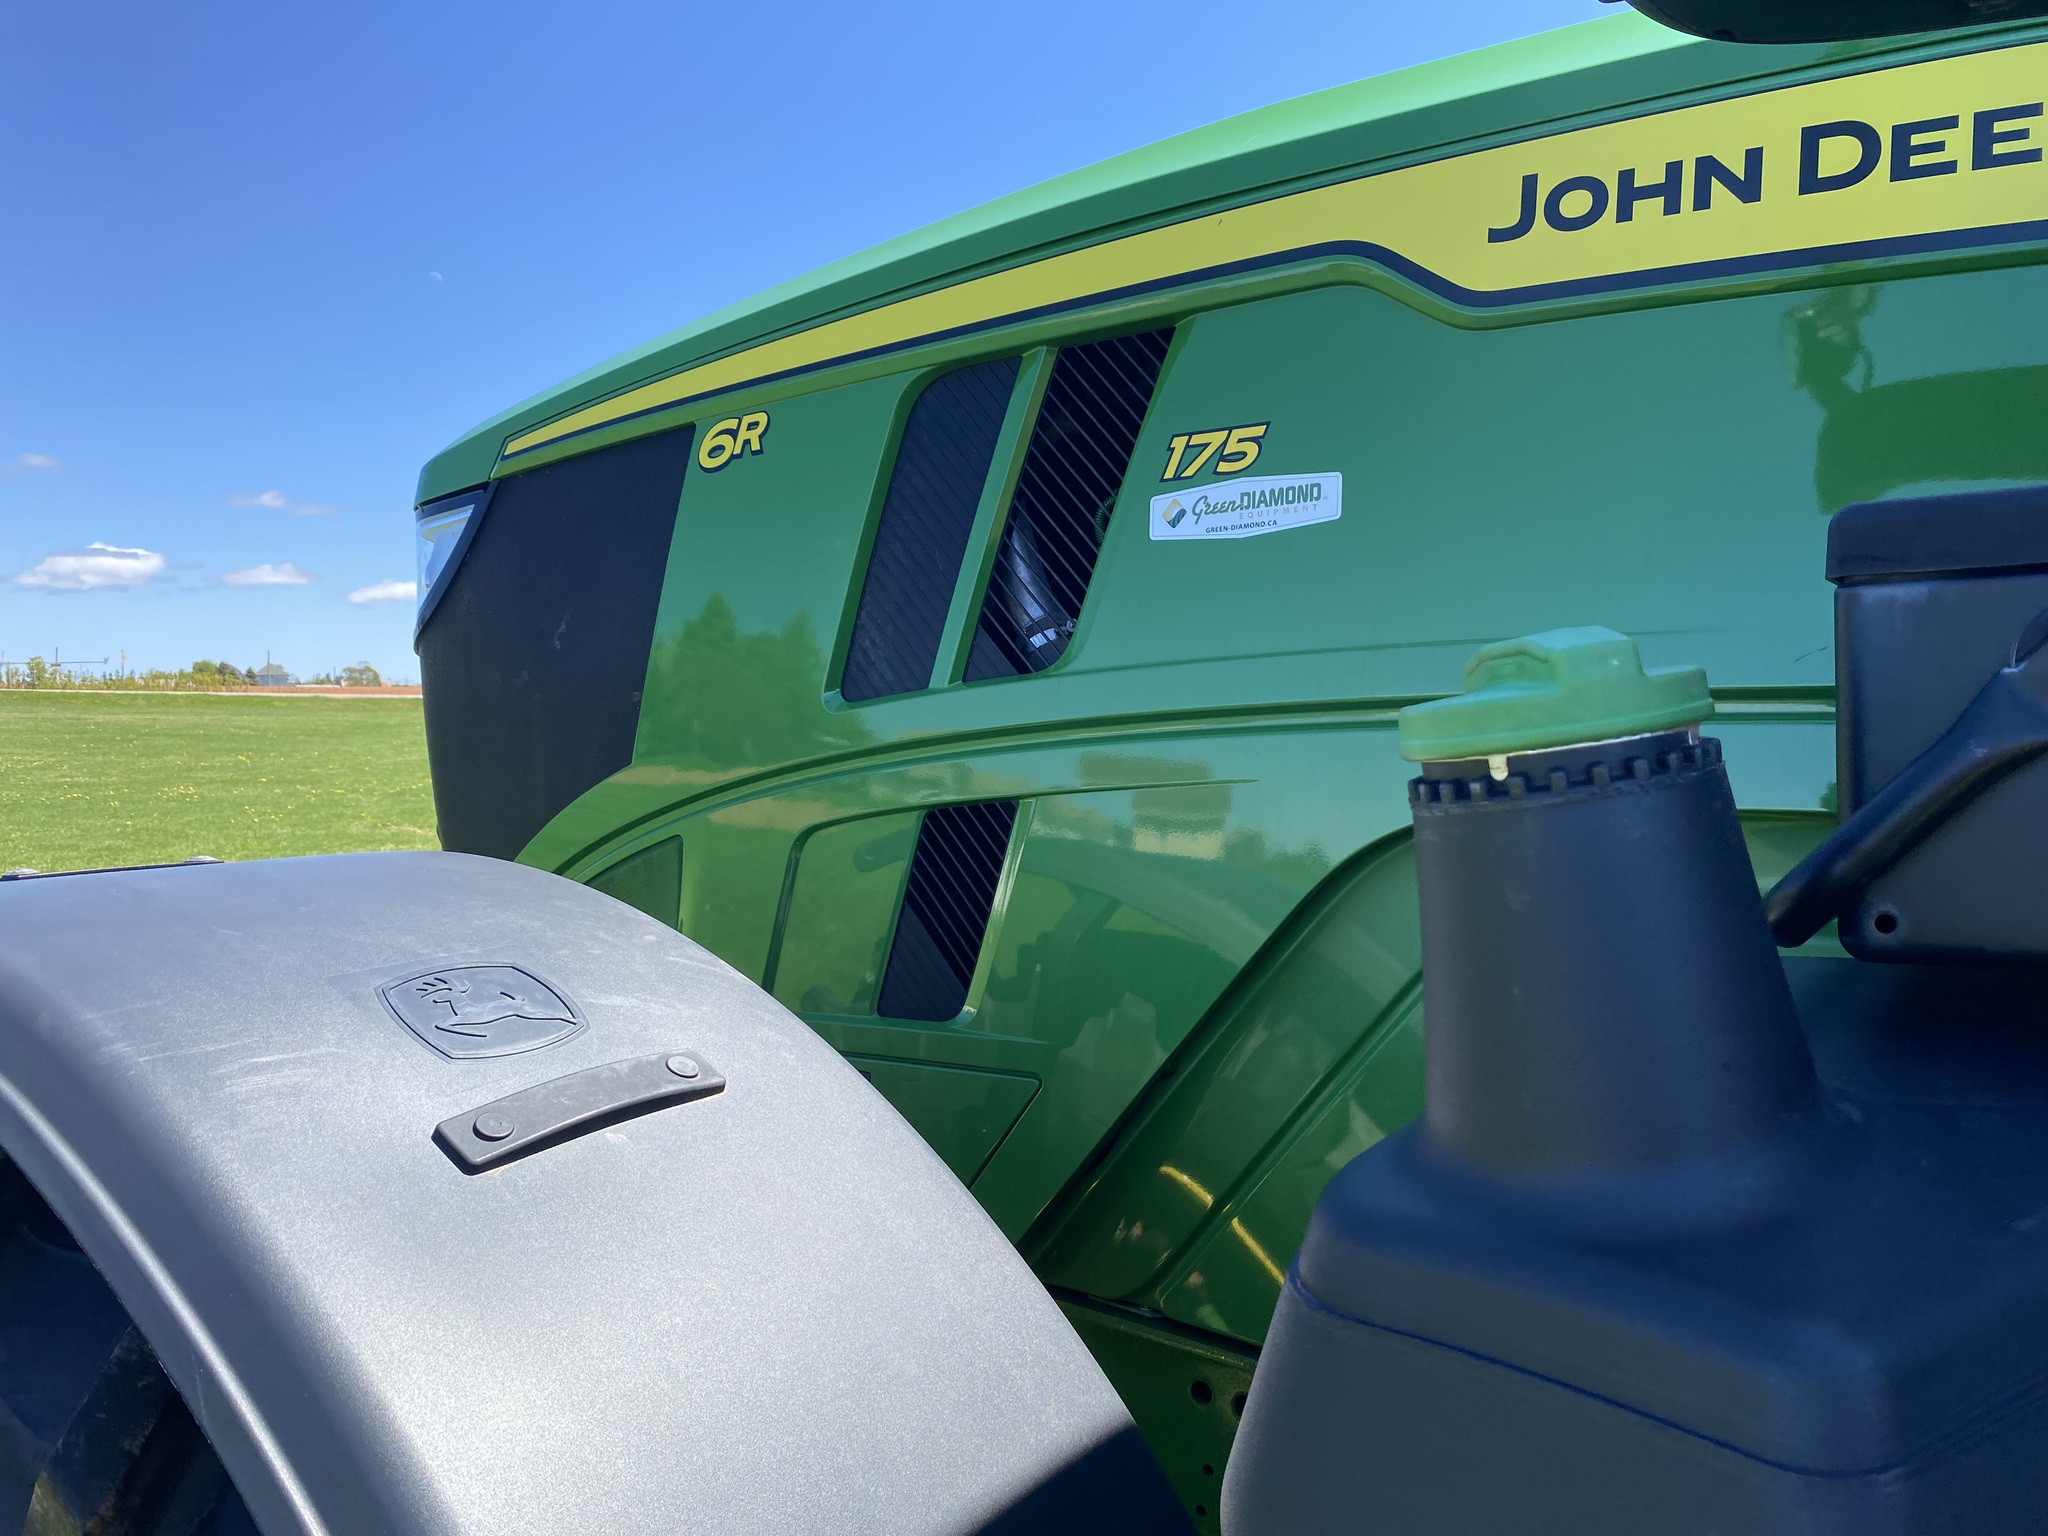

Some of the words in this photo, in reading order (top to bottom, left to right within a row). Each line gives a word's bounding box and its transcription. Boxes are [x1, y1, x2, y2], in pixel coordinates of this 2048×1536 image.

[1487, 146, 1764, 244] JOHN
[698, 410, 771, 474] 6R
[1159, 421, 1272, 483] 175
[1205, 519, 1278, 534] GREEN-DIAMOND.CA
[1239, 503, 1319, 520] EQUIPMENT
